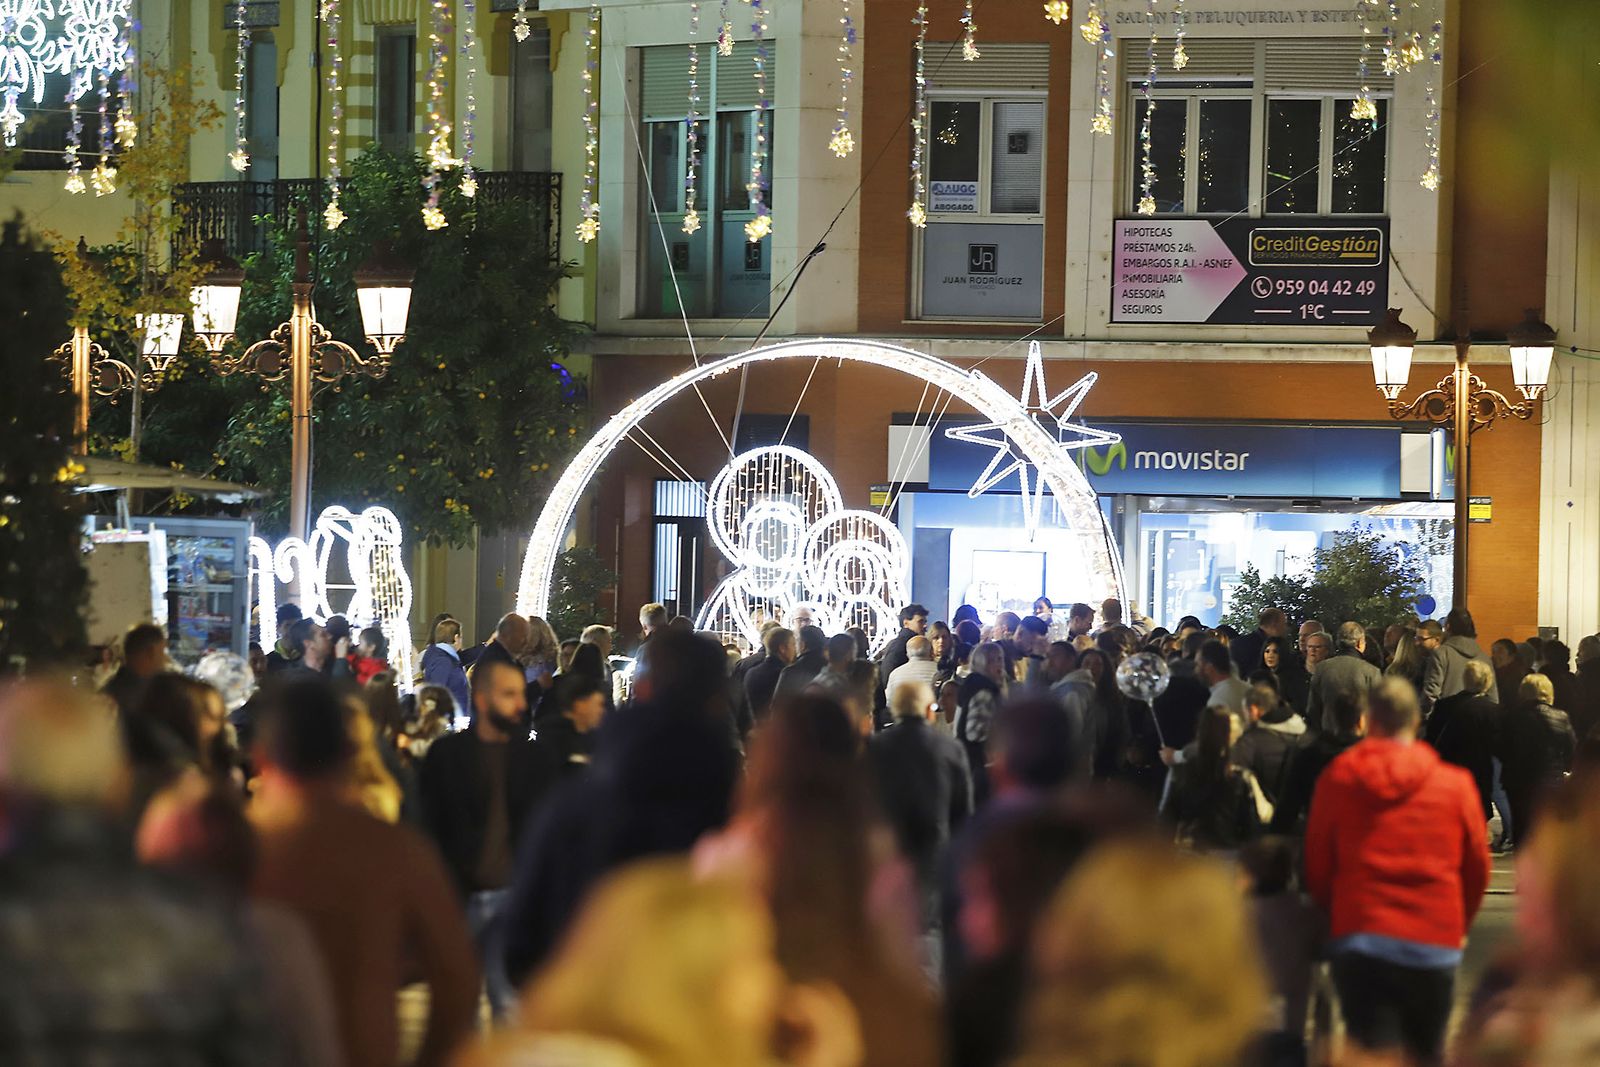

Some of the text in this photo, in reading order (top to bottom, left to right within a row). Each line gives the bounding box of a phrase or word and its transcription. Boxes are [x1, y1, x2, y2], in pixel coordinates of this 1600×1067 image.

[1297, 10, 1308, 23] Y
[945, 184, 976, 193] AUGC
[1123, 227, 1173, 237] HIPOTECAS
[1122, 241, 1197, 253] PRÉSTAMOS 24h.
[1253, 235, 1379, 252] CreditGestión
[972, 247, 994, 270] JR
[1122, 258, 1172, 268] EMBARGOS
[1174, 259, 1197, 268] R.A.I.
[1203, 259, 1233, 269] ASNEF
[942, 276, 967, 284] JUAN
[1122, 273, 1183, 284] INMOBILIARIA
[1121, 286, 1165, 299] ASESORÍA
[1275, 279, 1376, 295] 959 04 42 49
[1121, 304, 1163, 314] SEGUROS
[1299, 303, 1325, 320] 1ºC
[1134, 449, 1250, 471] movistar
